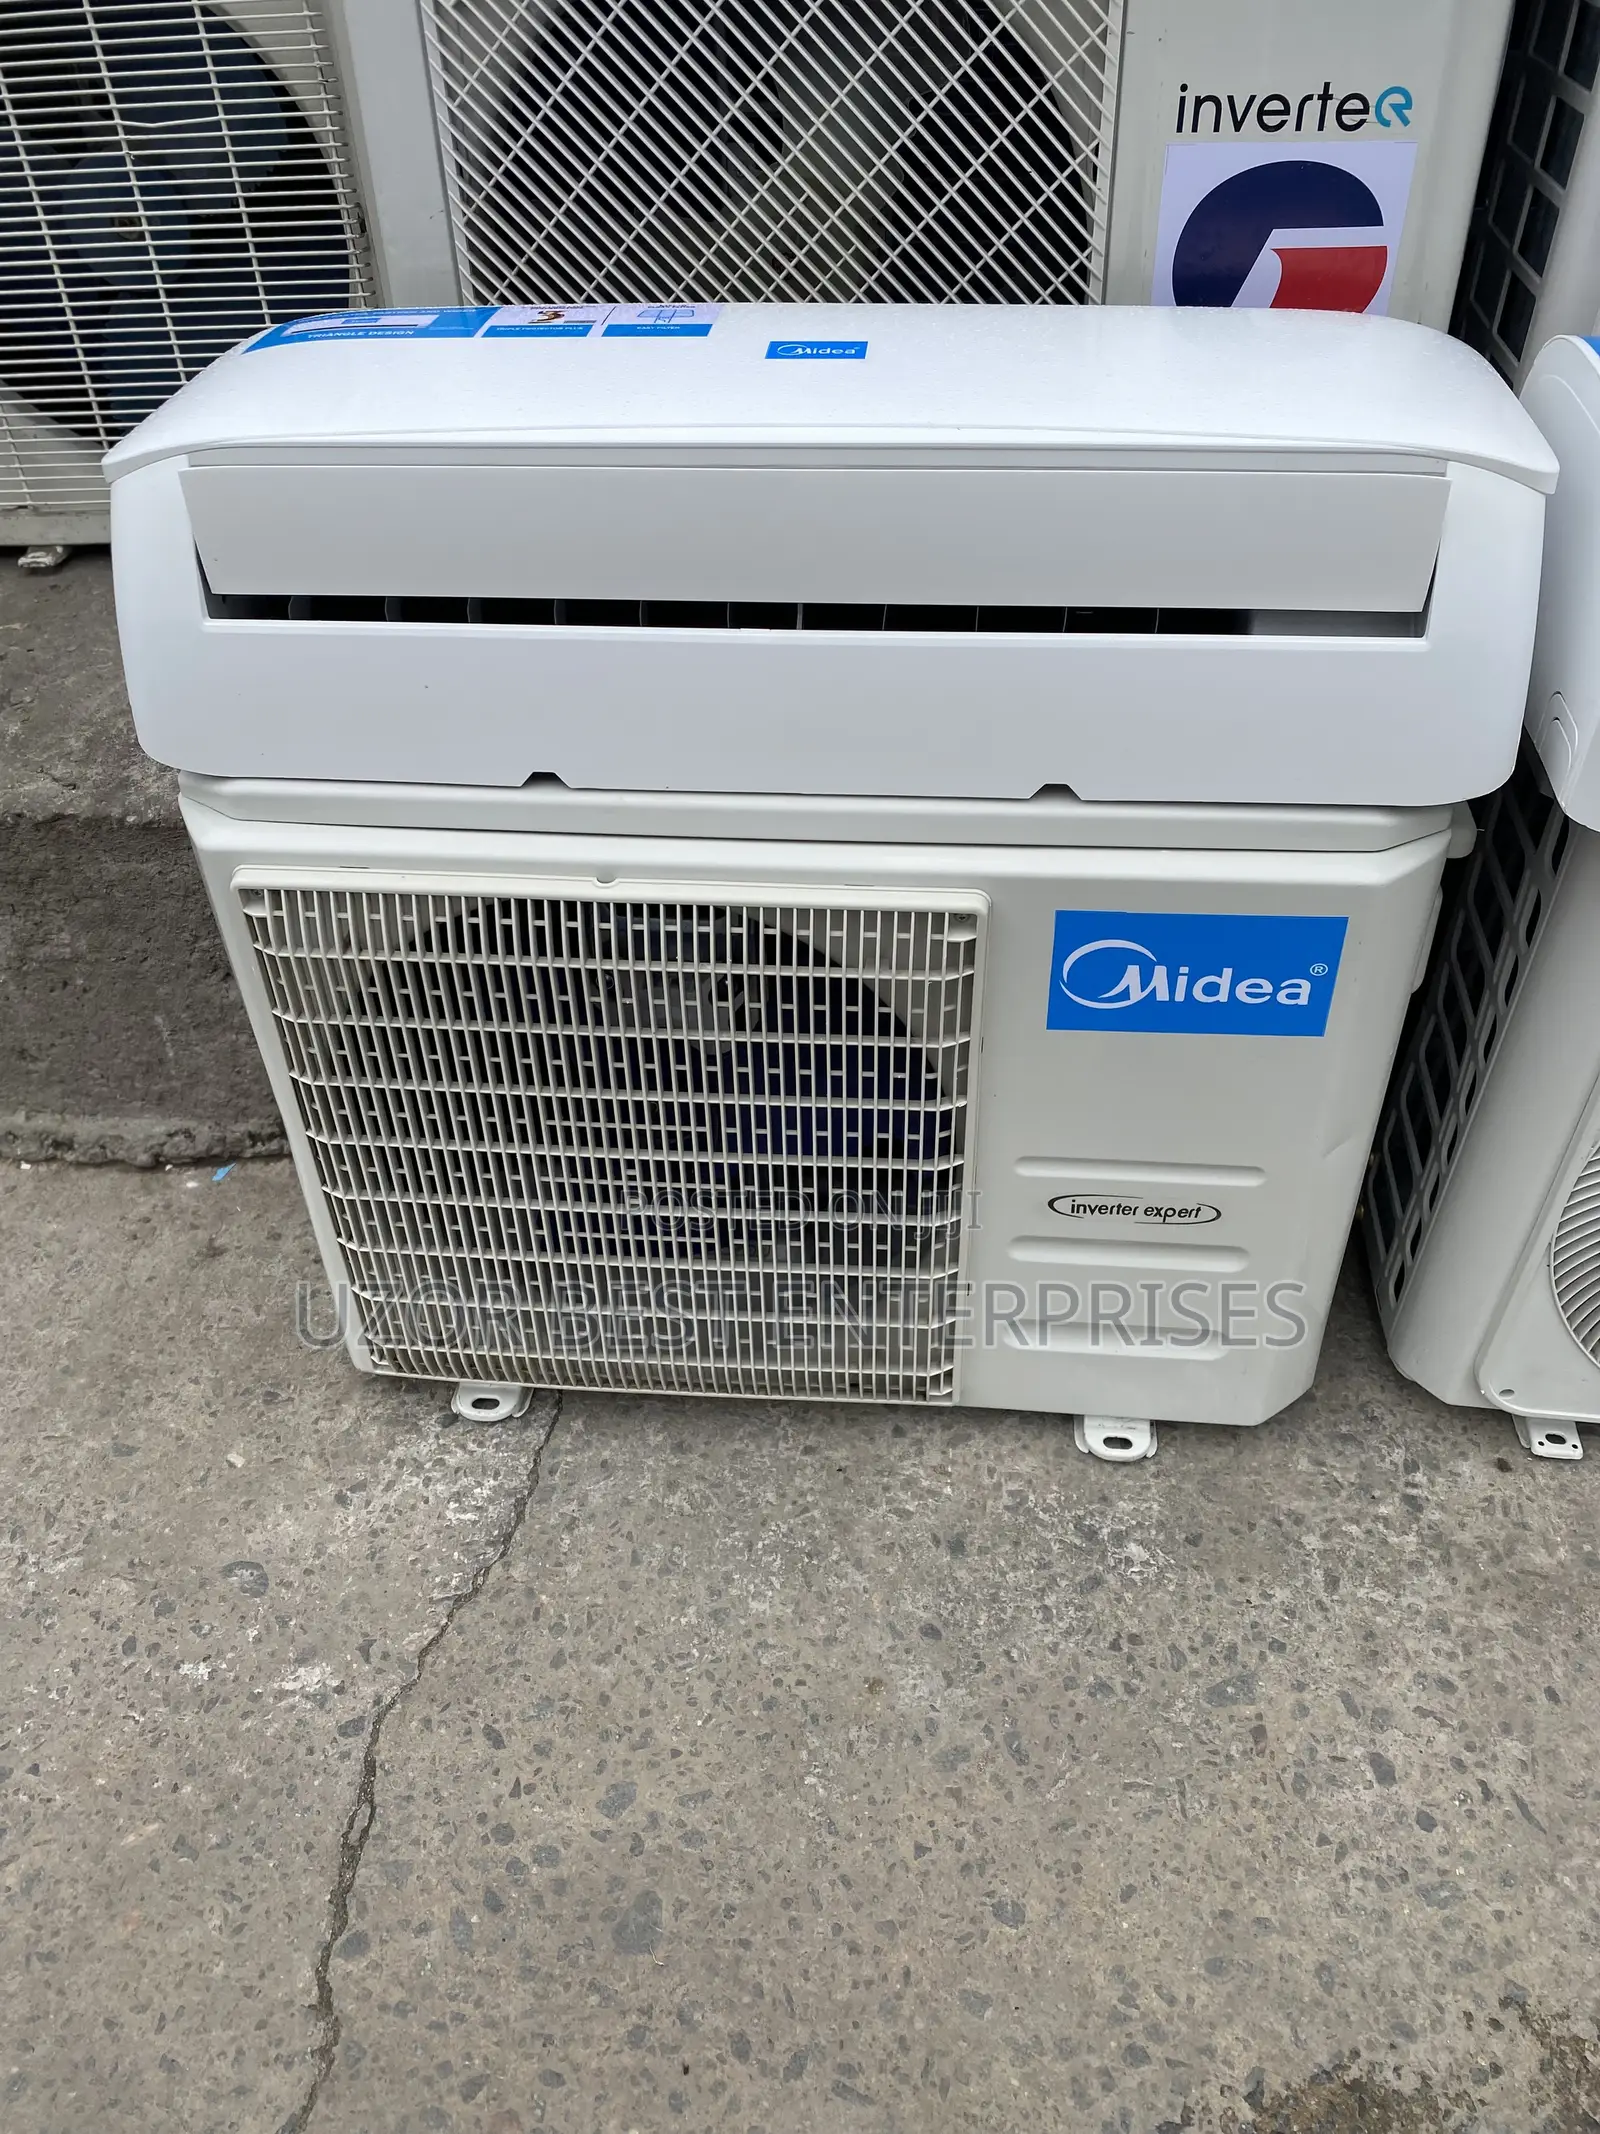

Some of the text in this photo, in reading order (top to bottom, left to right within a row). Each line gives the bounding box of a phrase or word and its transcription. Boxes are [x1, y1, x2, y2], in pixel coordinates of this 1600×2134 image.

[308, 331, 367, 339] TRIANGLE
[1070, 1199, 1202, 1223] inverter expert
